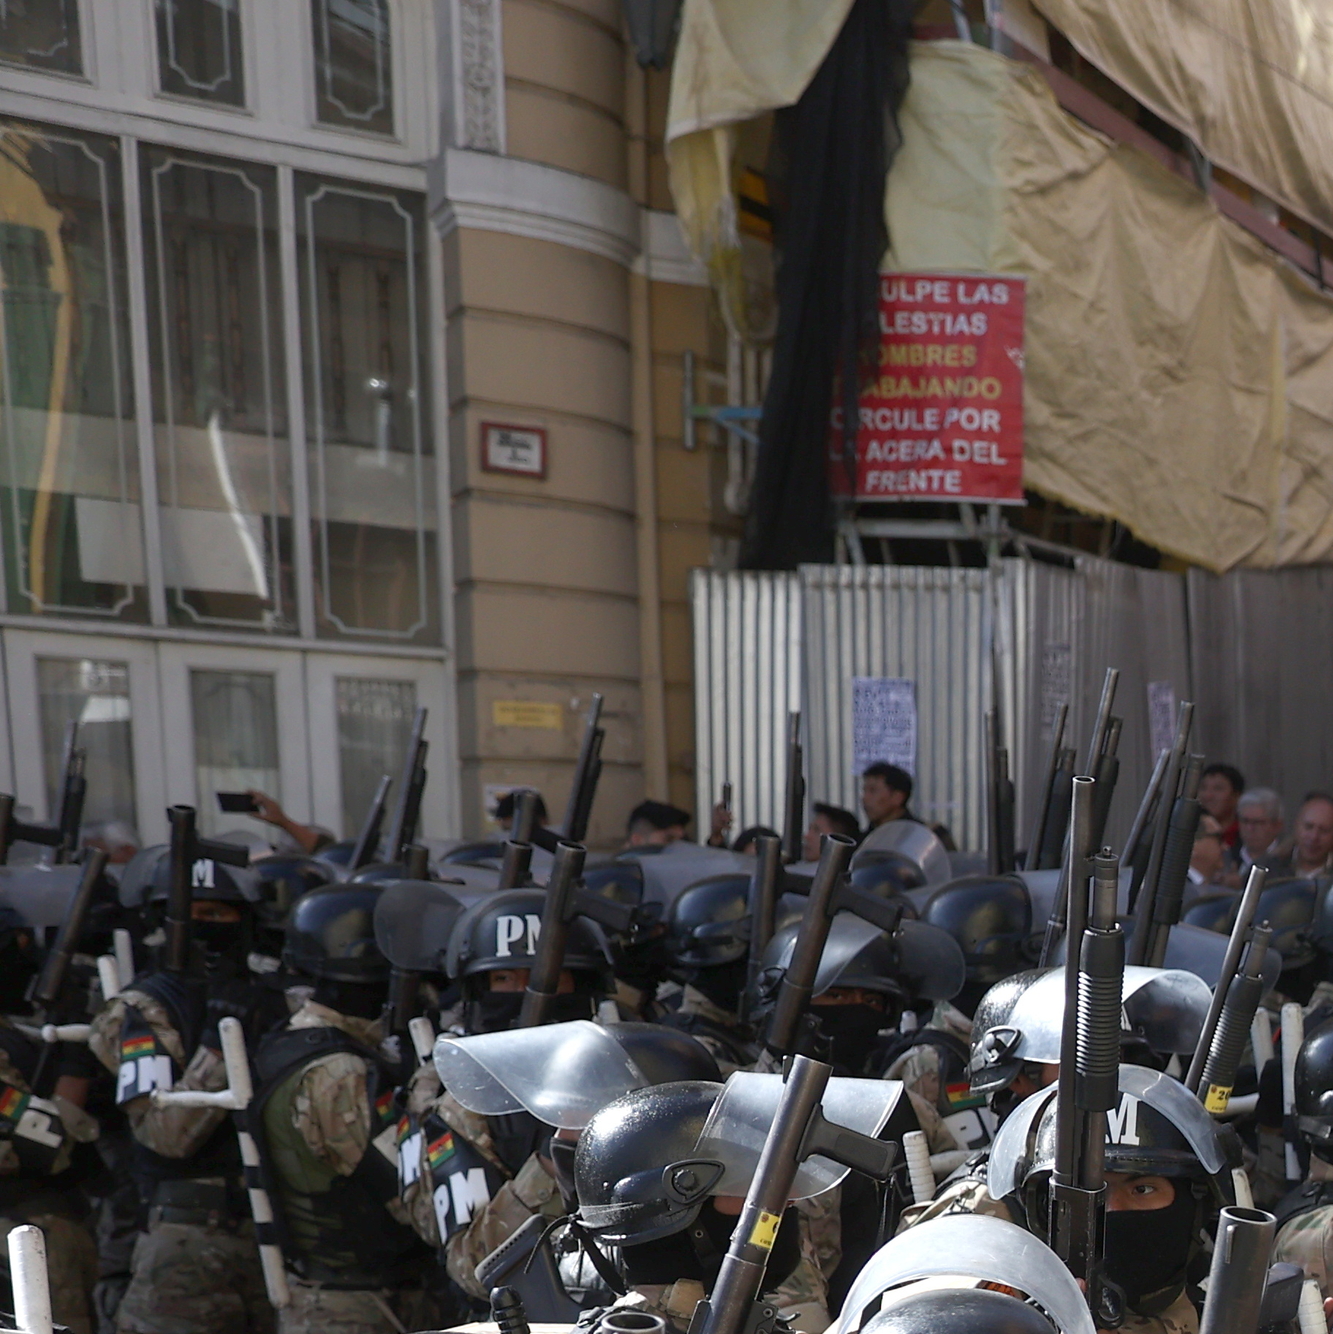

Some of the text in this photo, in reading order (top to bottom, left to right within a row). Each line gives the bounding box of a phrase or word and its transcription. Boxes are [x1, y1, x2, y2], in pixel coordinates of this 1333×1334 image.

[956, 282, 1010, 305] LAS
[878, 311, 988, 335] LESTIAS
[830, 407, 1001, 432] CRCULE POR
[865, 438, 946, 462] ACERA
[951, 438, 1008, 465] DEL
[864, 468, 962, 493] FRENTE
[192, 858, 216, 888] M
[115, 1054, 173, 1105] PM
[1105, 1092, 1140, 1146] M
[433, 1168, 491, 1245] PM
